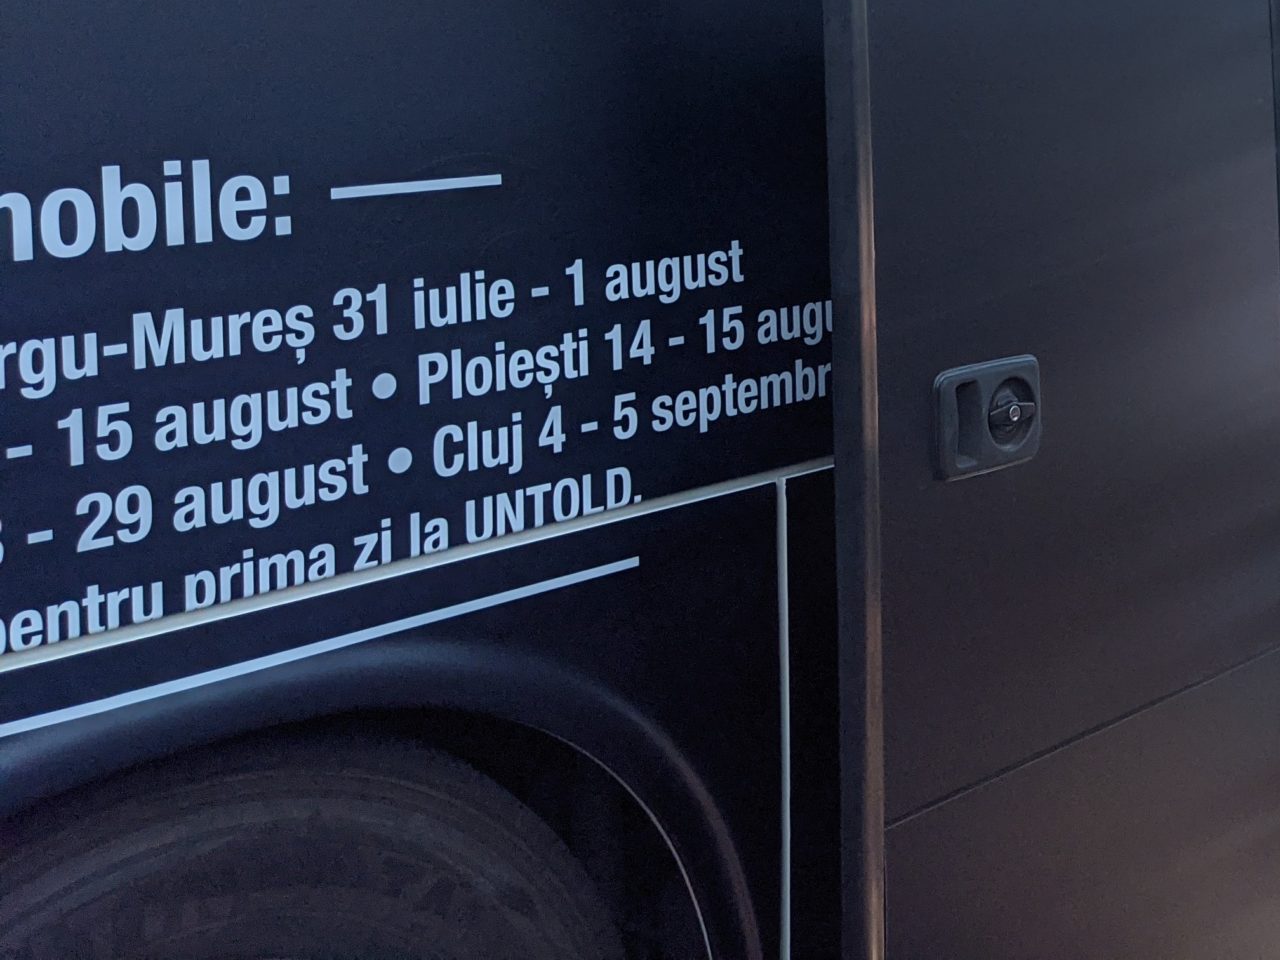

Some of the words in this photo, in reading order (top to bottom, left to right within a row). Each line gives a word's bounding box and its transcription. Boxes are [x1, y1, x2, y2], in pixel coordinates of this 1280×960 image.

[332, 282, 389, 342] 31
[413, 269, 516, 330] iulie
[565, 258, 585, 307] 1
[605, 239, 745, 304] august
[56, 401, 133, 467] 15
[153, 367, 354, 452] august
[417, 327, 589, 406] Ploiești
[604, 318, 656, 371] 14
[698, 305, 745, 354] 15
[75, 484, 153, 553] 29
[172, 443, 370, 533] august
[432, 411, 523, 478] Cluj
[538, 404, 567, 454] 4
[612, 391, 638, 440] 5
[651, 358, 832, 433] septembr
[0, 579, 164, 655] entru
[184, 540, 336, 613] prima
[353, 510, 393, 572] zi
[410, 510, 449, 559] la
